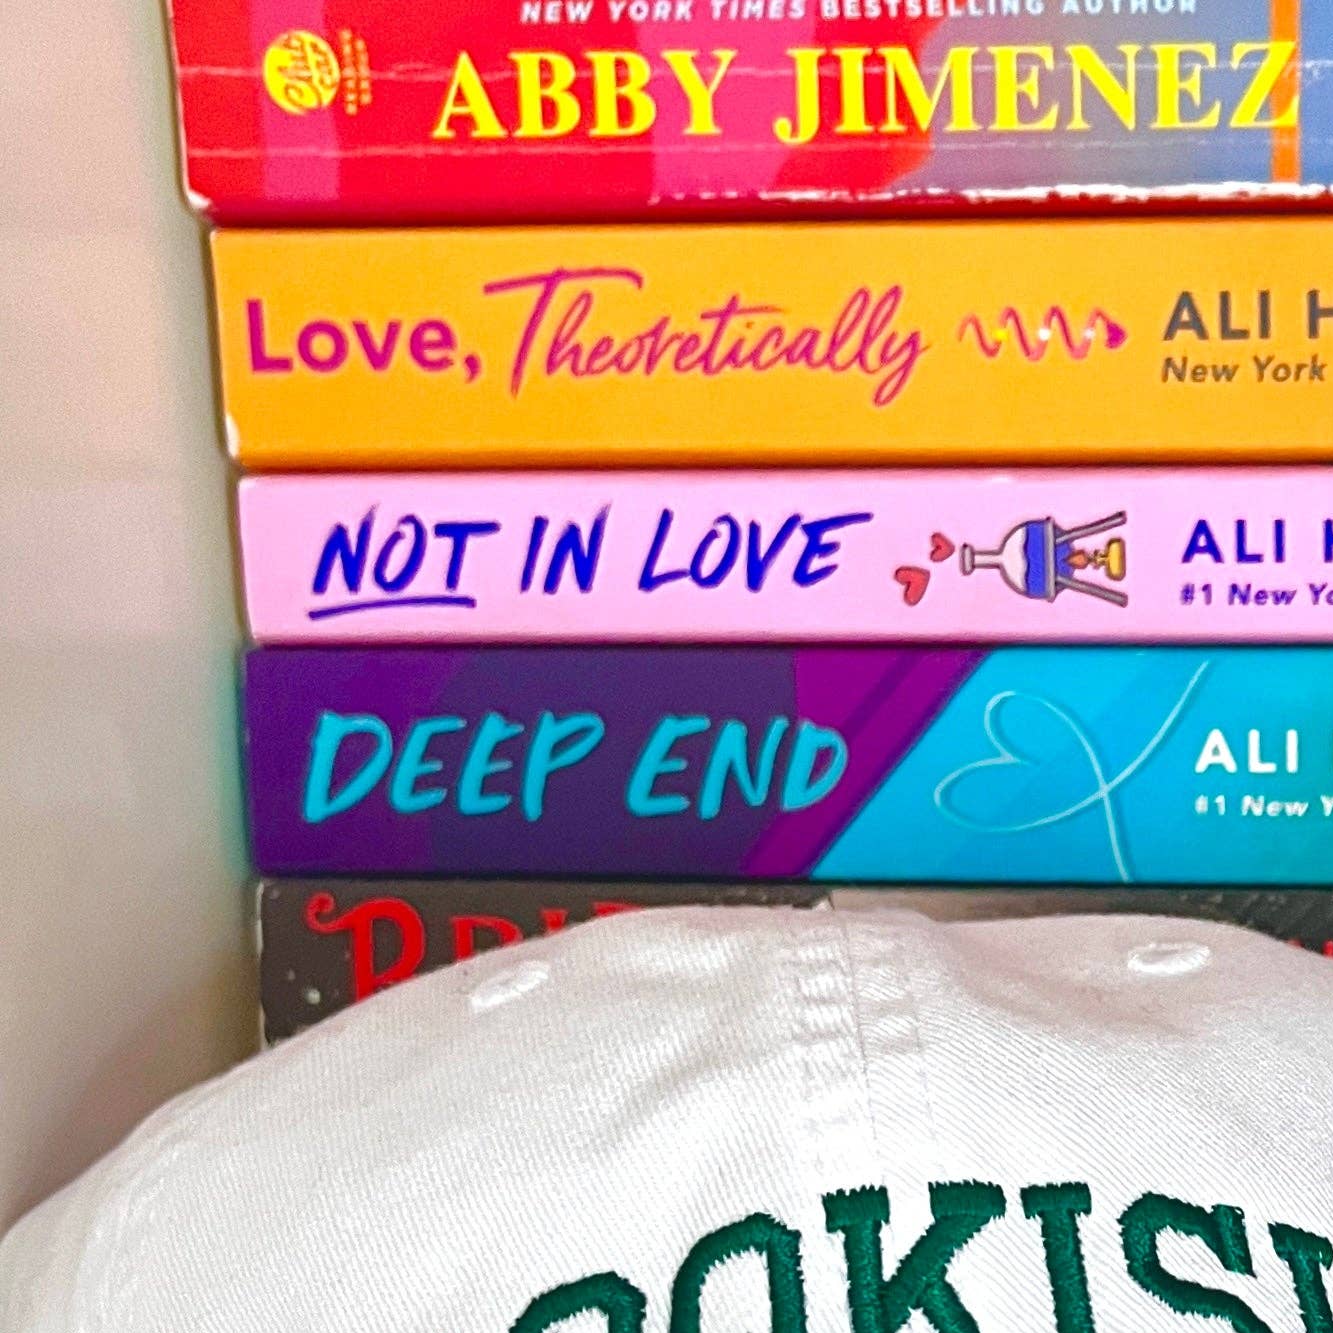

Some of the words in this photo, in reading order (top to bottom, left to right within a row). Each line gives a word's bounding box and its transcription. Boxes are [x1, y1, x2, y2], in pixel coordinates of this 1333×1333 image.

[520, 0, 592, 23] NEW
[608, 0, 694, 22] YORK
[711, 0, 806, 21] TIMES
[820, 0, 1045, 20] BESTSELLING
[432, 50, 736, 138] ABBY
[773, 40, 1300, 143] JIMENEZ
[246, 298, 481, 384] Love,
[483, 267, 930, 407] Theoretically
[1163, 289, 1272, 341] ALI
[1161, 355, 1239, 384] New
[1253, 354, 1327, 383] York
[312, 504, 501, 594] NOT
[520, 503, 611, 593] IN
[638, 508, 874, 593] LOVE
[1181, 518, 1286, 563] ALI
[1180, 583, 1213, 605] #1
[1228, 583, 1297, 606] New
[304, 710, 605, 822] DEEP
[627, 714, 848, 821] END
[1195, 728, 1299, 774] ALI
[1194, 795, 1226, 816] #1
[1241, 794, 1309, 817] New
